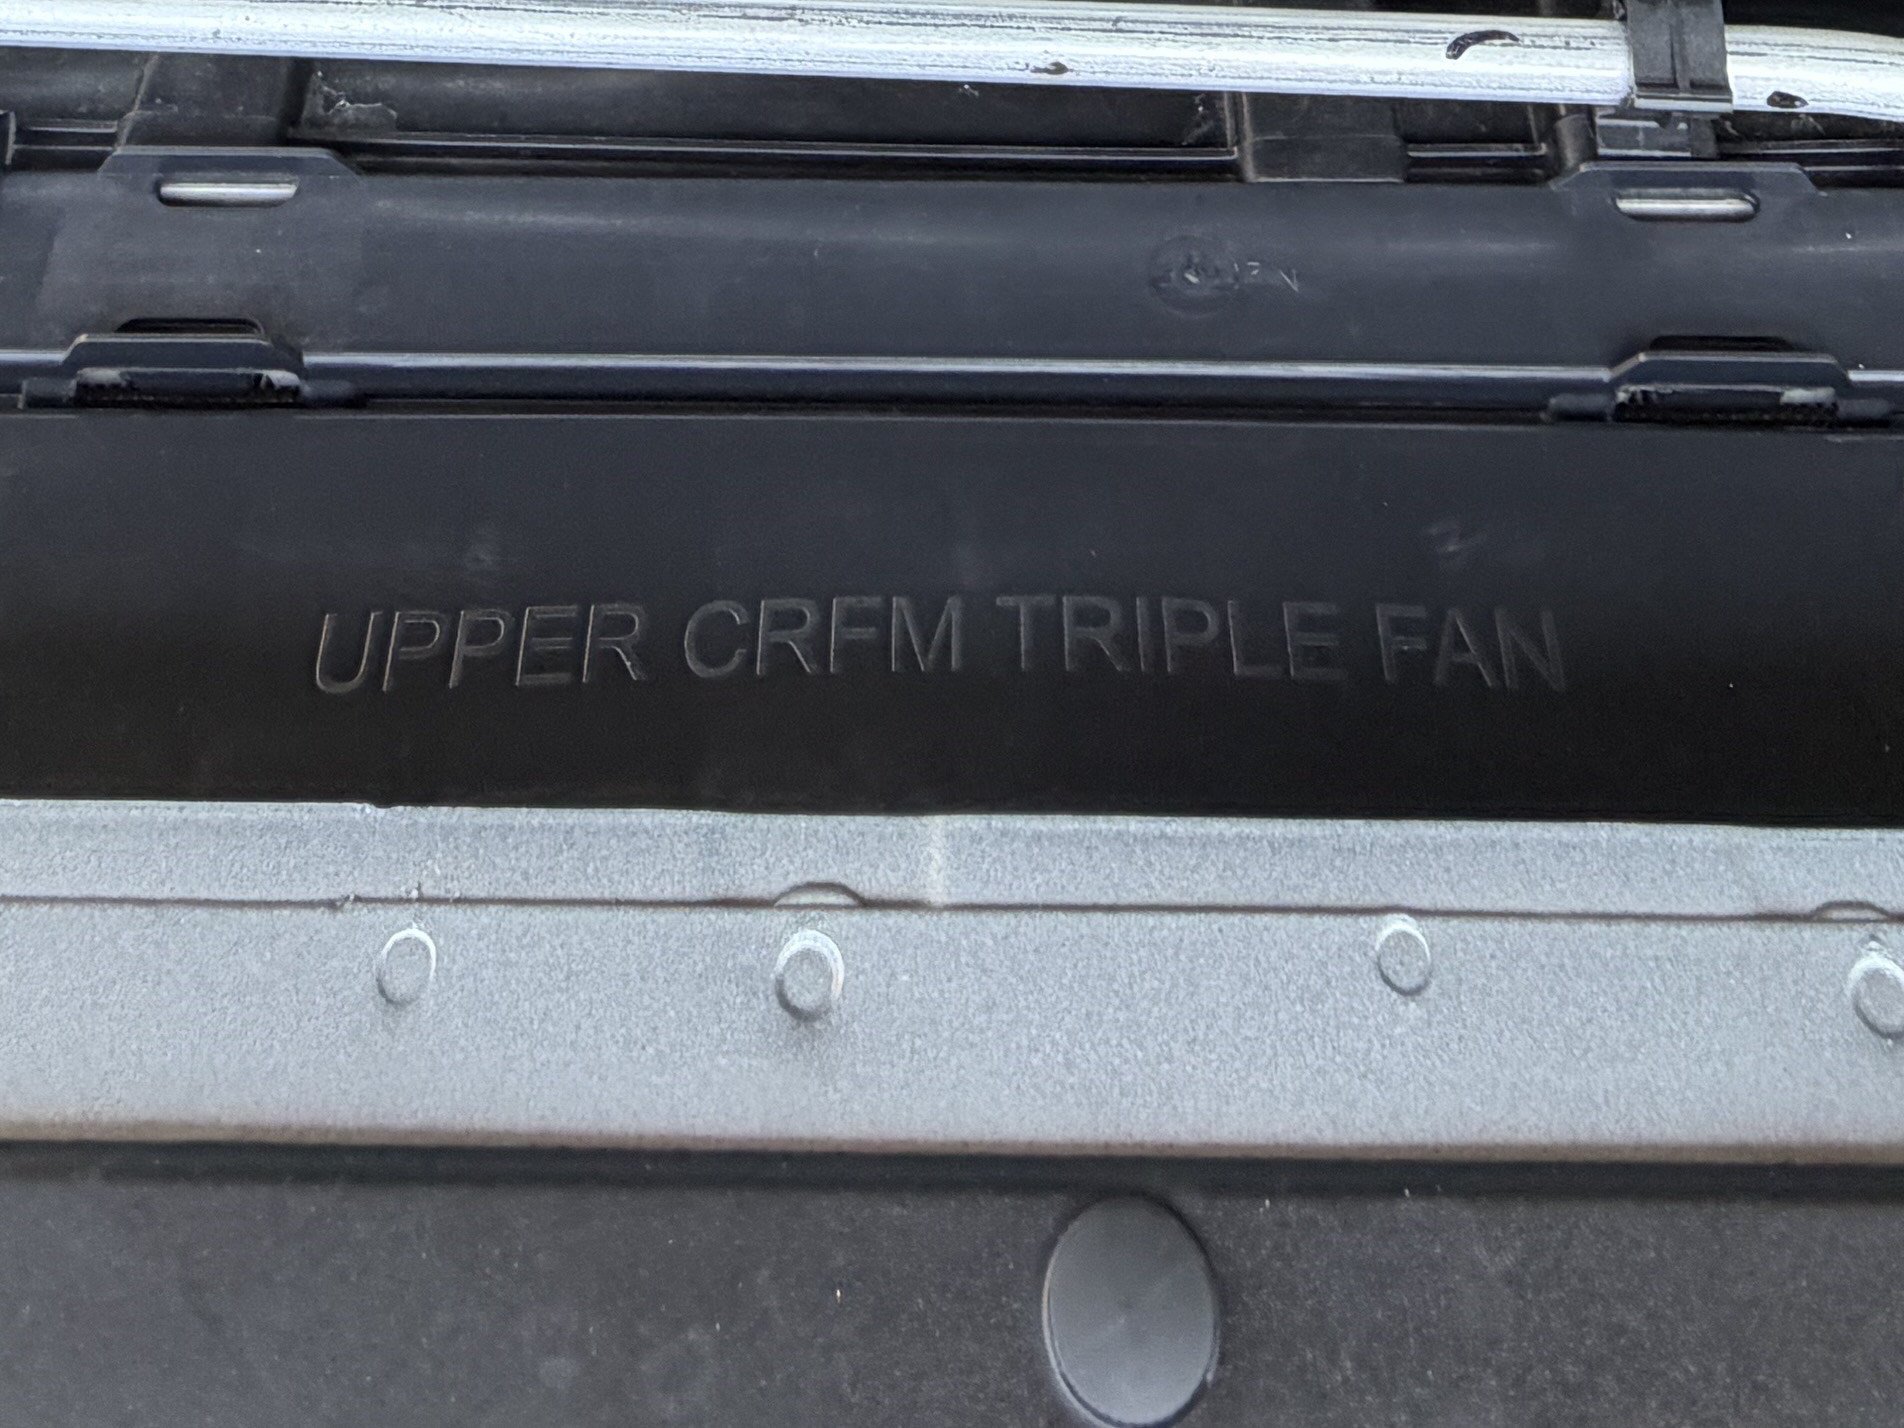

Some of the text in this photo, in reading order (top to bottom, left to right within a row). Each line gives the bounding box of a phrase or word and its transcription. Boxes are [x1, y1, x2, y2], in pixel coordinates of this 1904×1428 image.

[314, 593, 1568, 694] UPPER CRFM TRIPLE FAN
